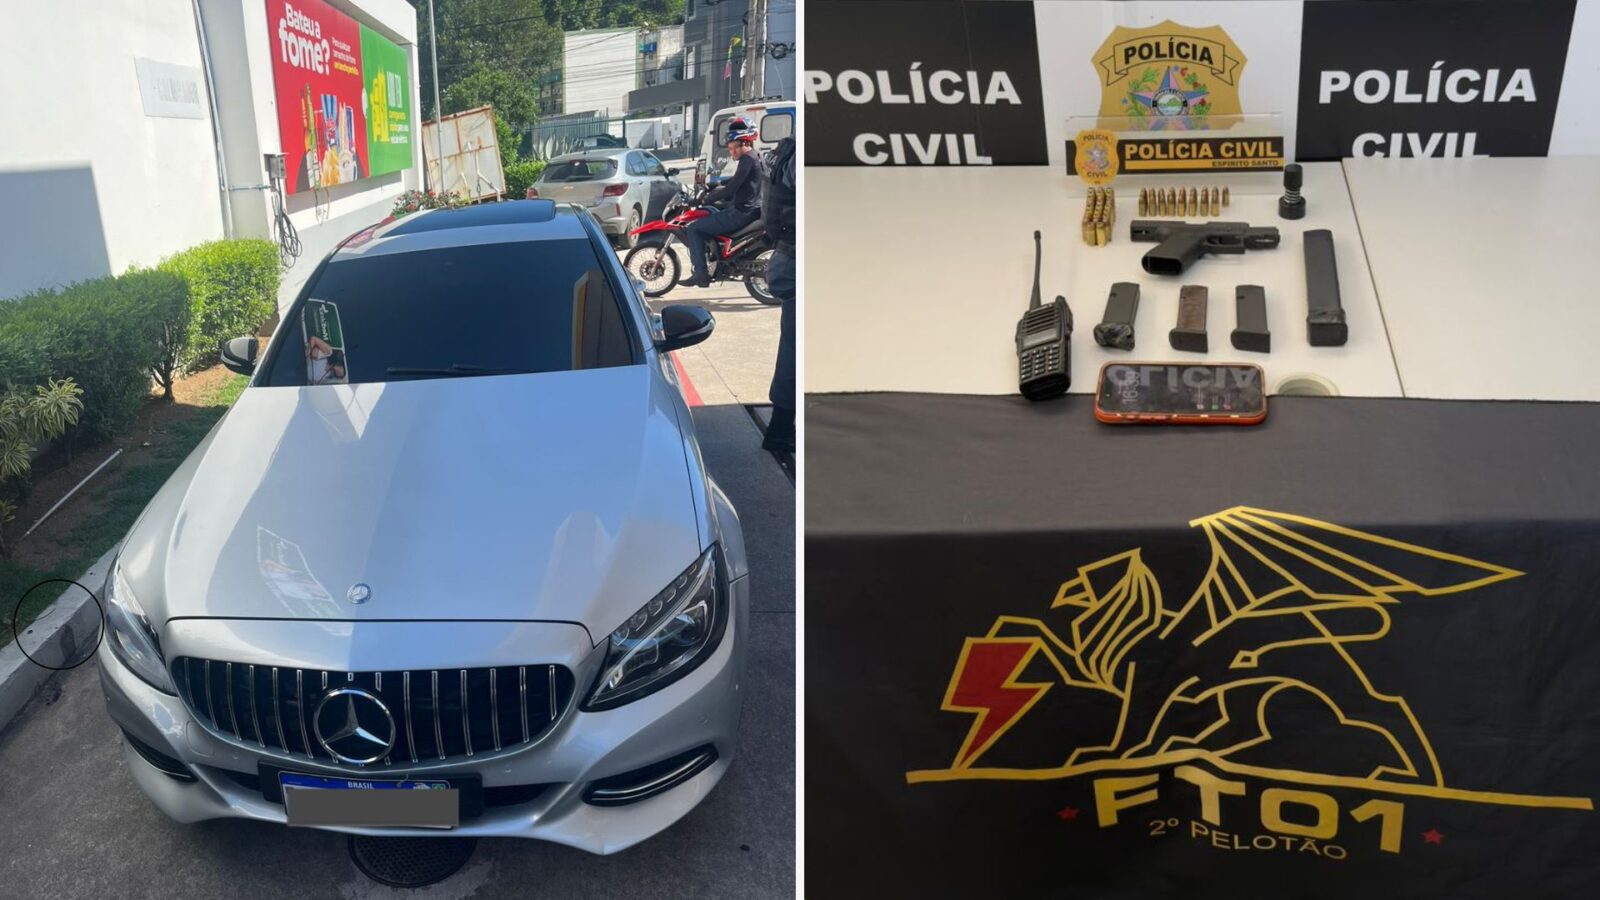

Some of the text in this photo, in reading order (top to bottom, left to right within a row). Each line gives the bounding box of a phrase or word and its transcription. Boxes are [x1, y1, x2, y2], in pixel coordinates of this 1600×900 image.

[285, 2, 321, 39] Bateu a
[278, 17, 330, 76] fome?
[1123, 36, 1215, 66] POLÍCIA
[804, 61, 1023, 105] POLÍCIA
[1318, 60, 1537, 104] POLÍCIA
[852, 132, 993, 165] CIVIL
[1124, 139, 1279, 160] POLÍCIA CIVIL
[1351, 131, 1491, 159] CIVIL
[1251, 159, 1279, 167] SANTO
[347, 781, 374, 790] BRASIL
[1190, 821, 1348, 860] PELOTÃO
